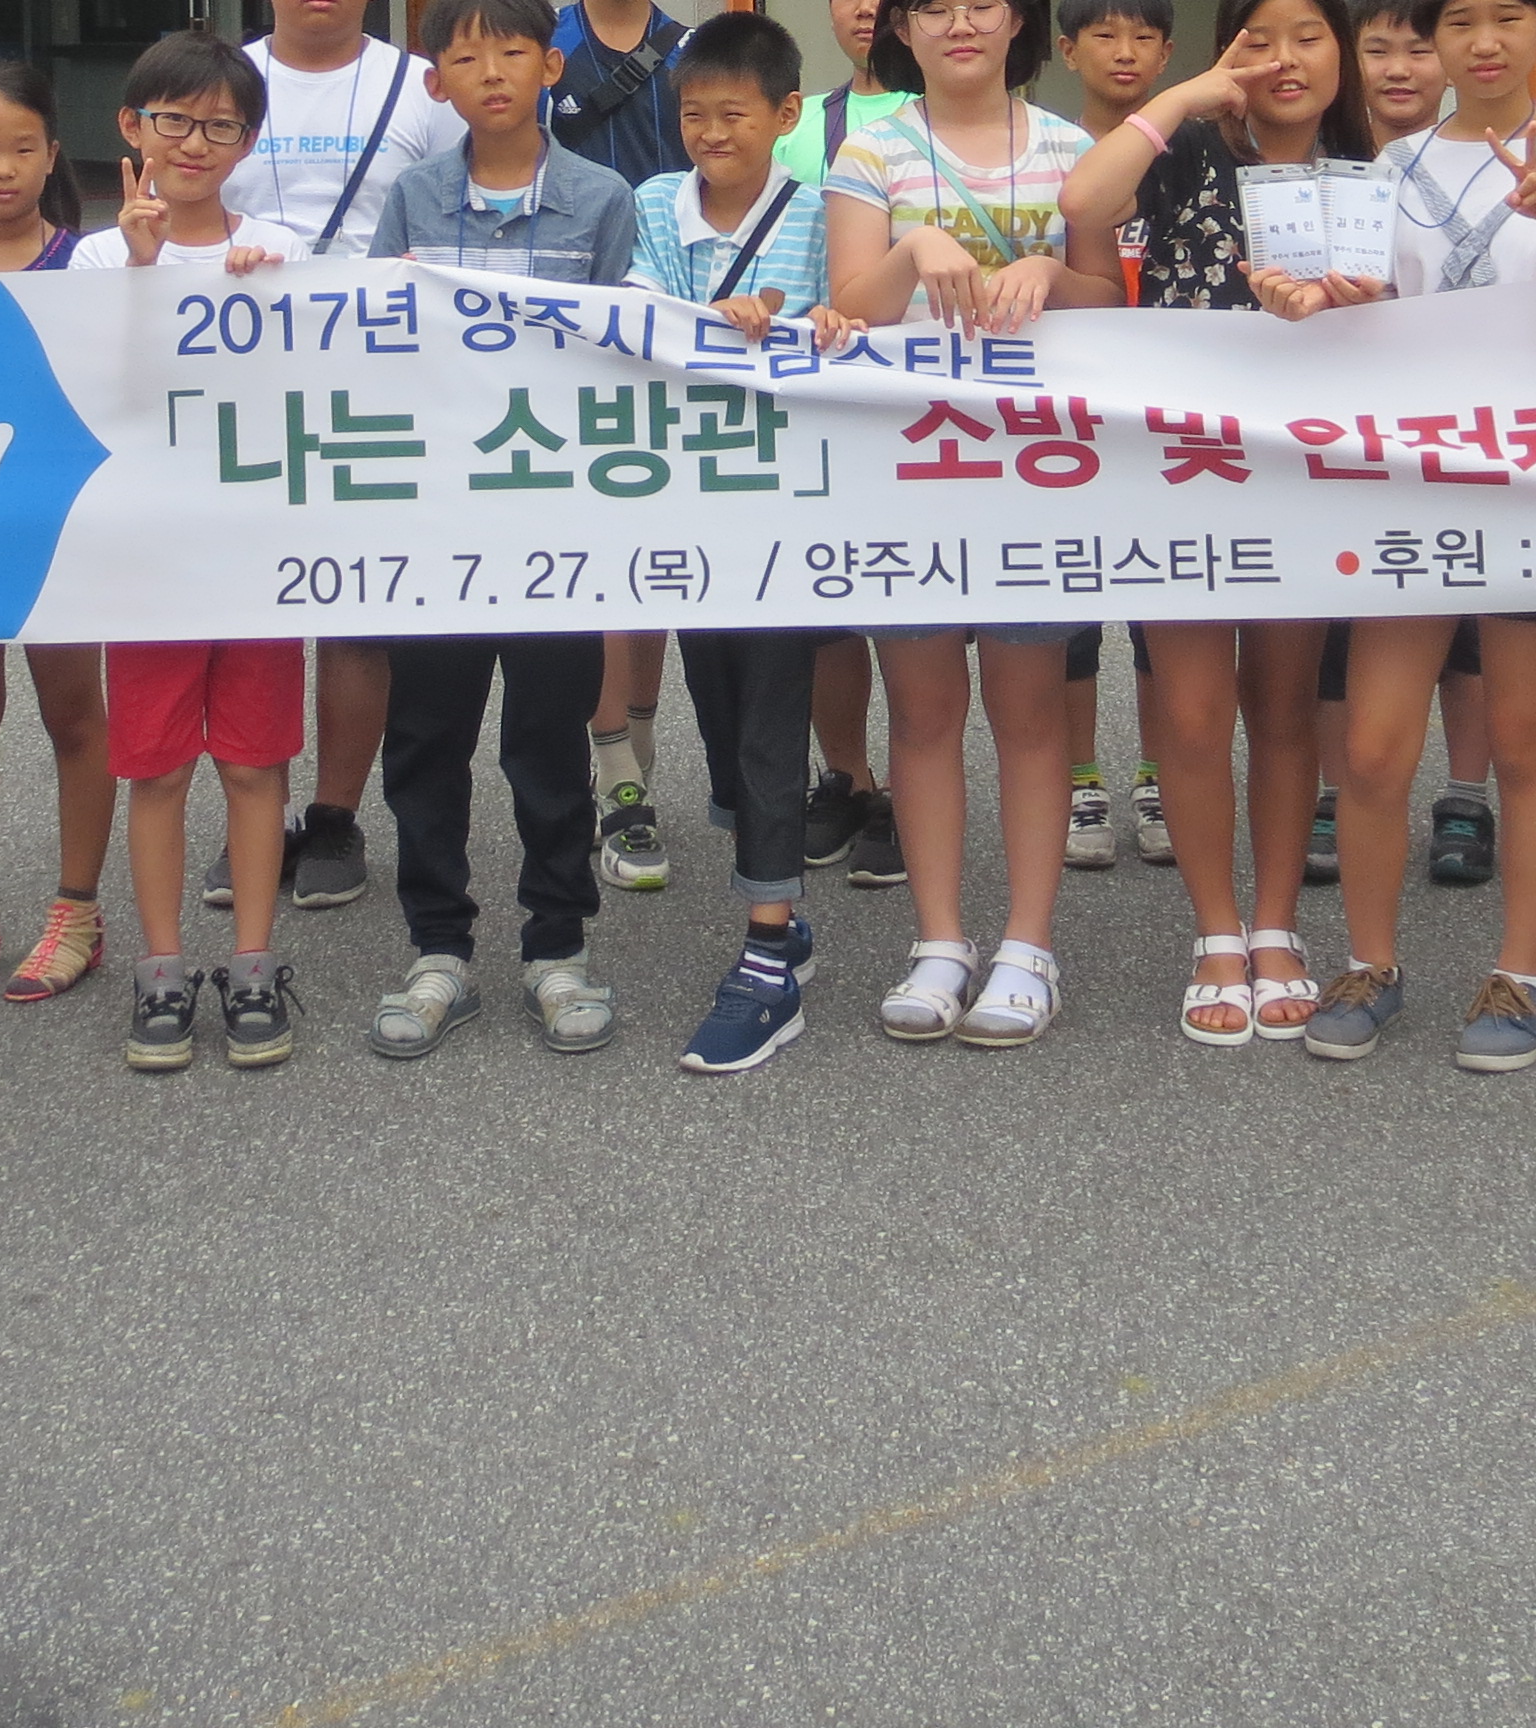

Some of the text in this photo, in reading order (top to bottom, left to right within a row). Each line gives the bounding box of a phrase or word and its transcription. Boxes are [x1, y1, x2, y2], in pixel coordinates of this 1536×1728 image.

[176, 282, 1045, 389] 2017년 양주시 드림스타트
[167, 387, 427, 505] 「나는
[467, 379, 831, 499] 소방관」
[896, 395, 1105, 489] 소방
[1146, 405, 1252, 486] 및
[275, 555, 426, 607] 2017.
[450, 553, 499, 604] 7.
[525, 550, 605, 602] 27.
[627, 544, 712, 603] (목)
[805, 537, 969, 599] 양주시
[995, 533, 1282, 593] 드림스타트
